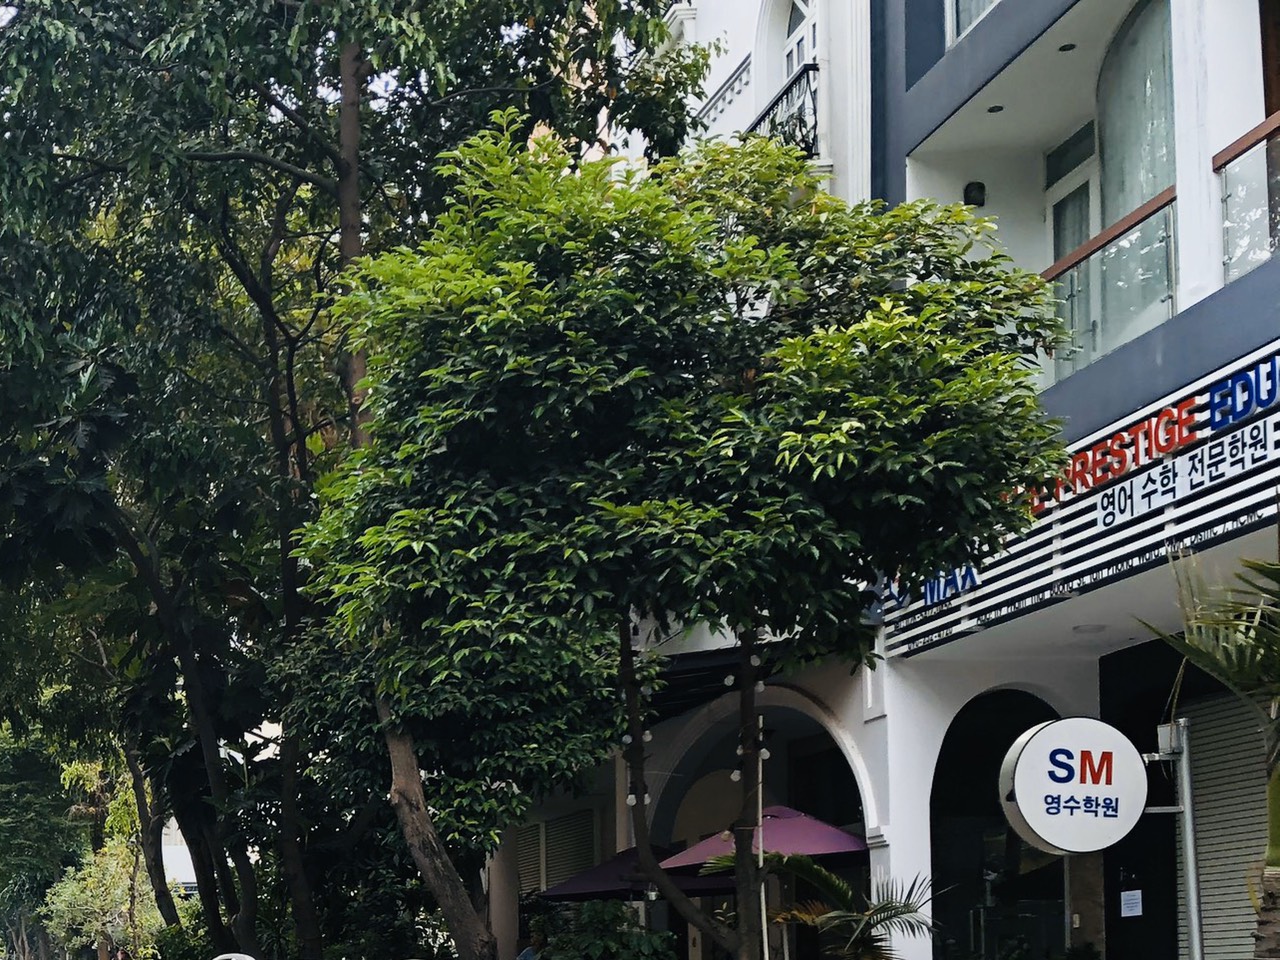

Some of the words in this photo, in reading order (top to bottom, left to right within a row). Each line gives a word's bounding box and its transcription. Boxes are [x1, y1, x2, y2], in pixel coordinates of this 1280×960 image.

[1100, 480, 1134, 528] 영어
[1141, 461, 1177, 509] 수학
[1187, 420, 1268, 490] 전문학원
[1047, 748, 1114, 785] SM
[1044, 794, 1119, 818] 영수학원
